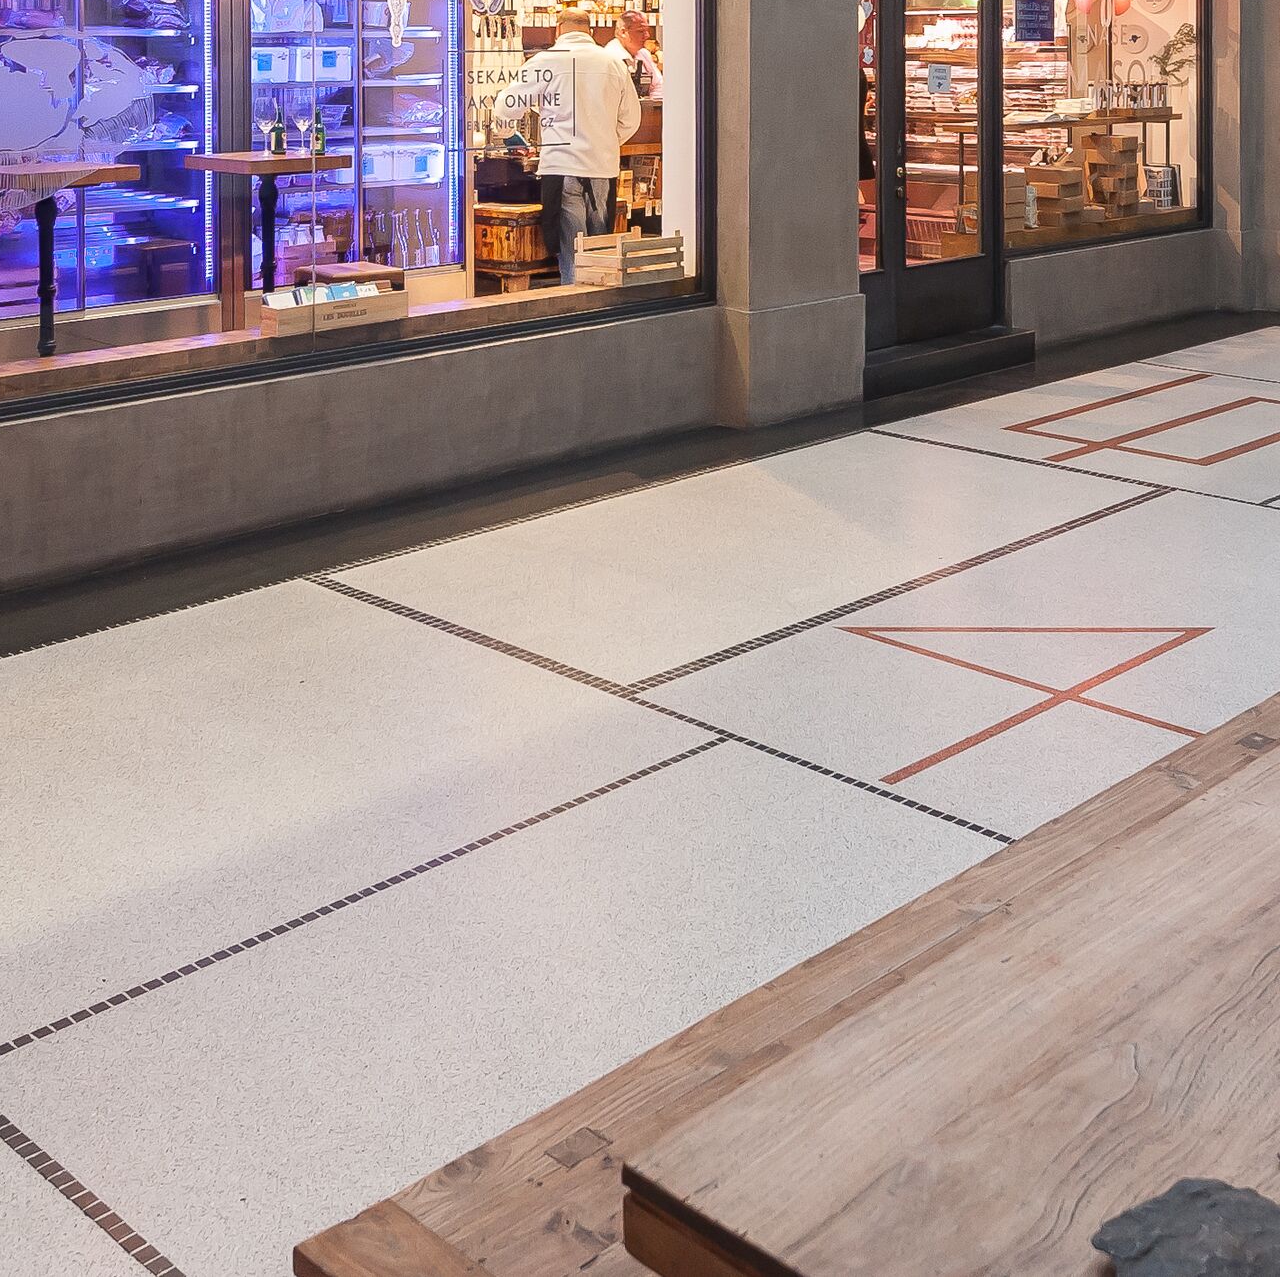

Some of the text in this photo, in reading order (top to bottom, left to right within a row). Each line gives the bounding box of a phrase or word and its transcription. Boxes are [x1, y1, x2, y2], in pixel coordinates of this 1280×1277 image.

[467, 66, 553, 84] SEKÁME TO
[504, 92, 561, 109] ONLINE
